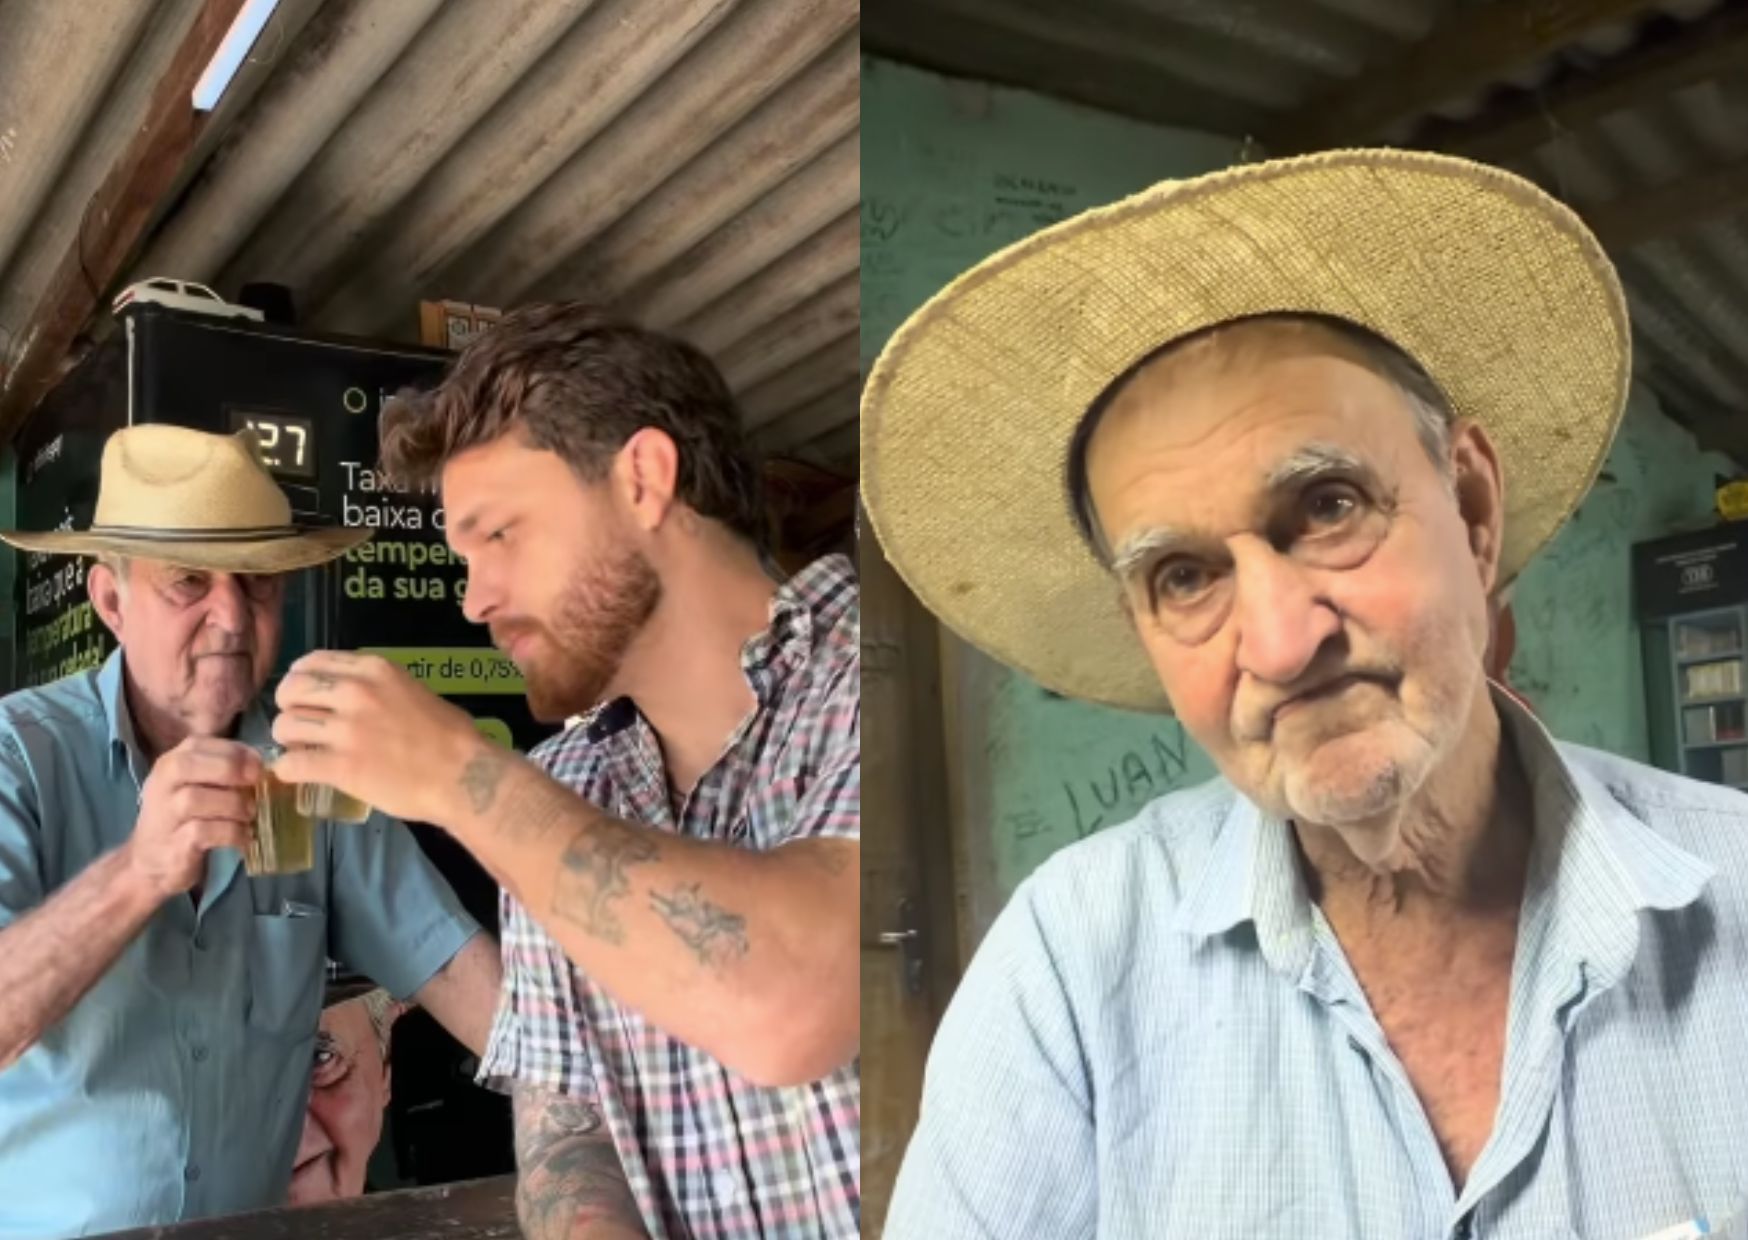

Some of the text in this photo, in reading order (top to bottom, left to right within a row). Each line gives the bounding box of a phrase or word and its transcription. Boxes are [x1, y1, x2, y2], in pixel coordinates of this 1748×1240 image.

[342, 494, 423, 529] baixa
[346, 540, 469, 570] temper
[344, 566, 386, 600] da
[393, 574, 447, 600] sua
[407, 655, 434, 679] rtir
[439, 654, 466, 679] de
[1063, 720, 1188, 839] LUAN
